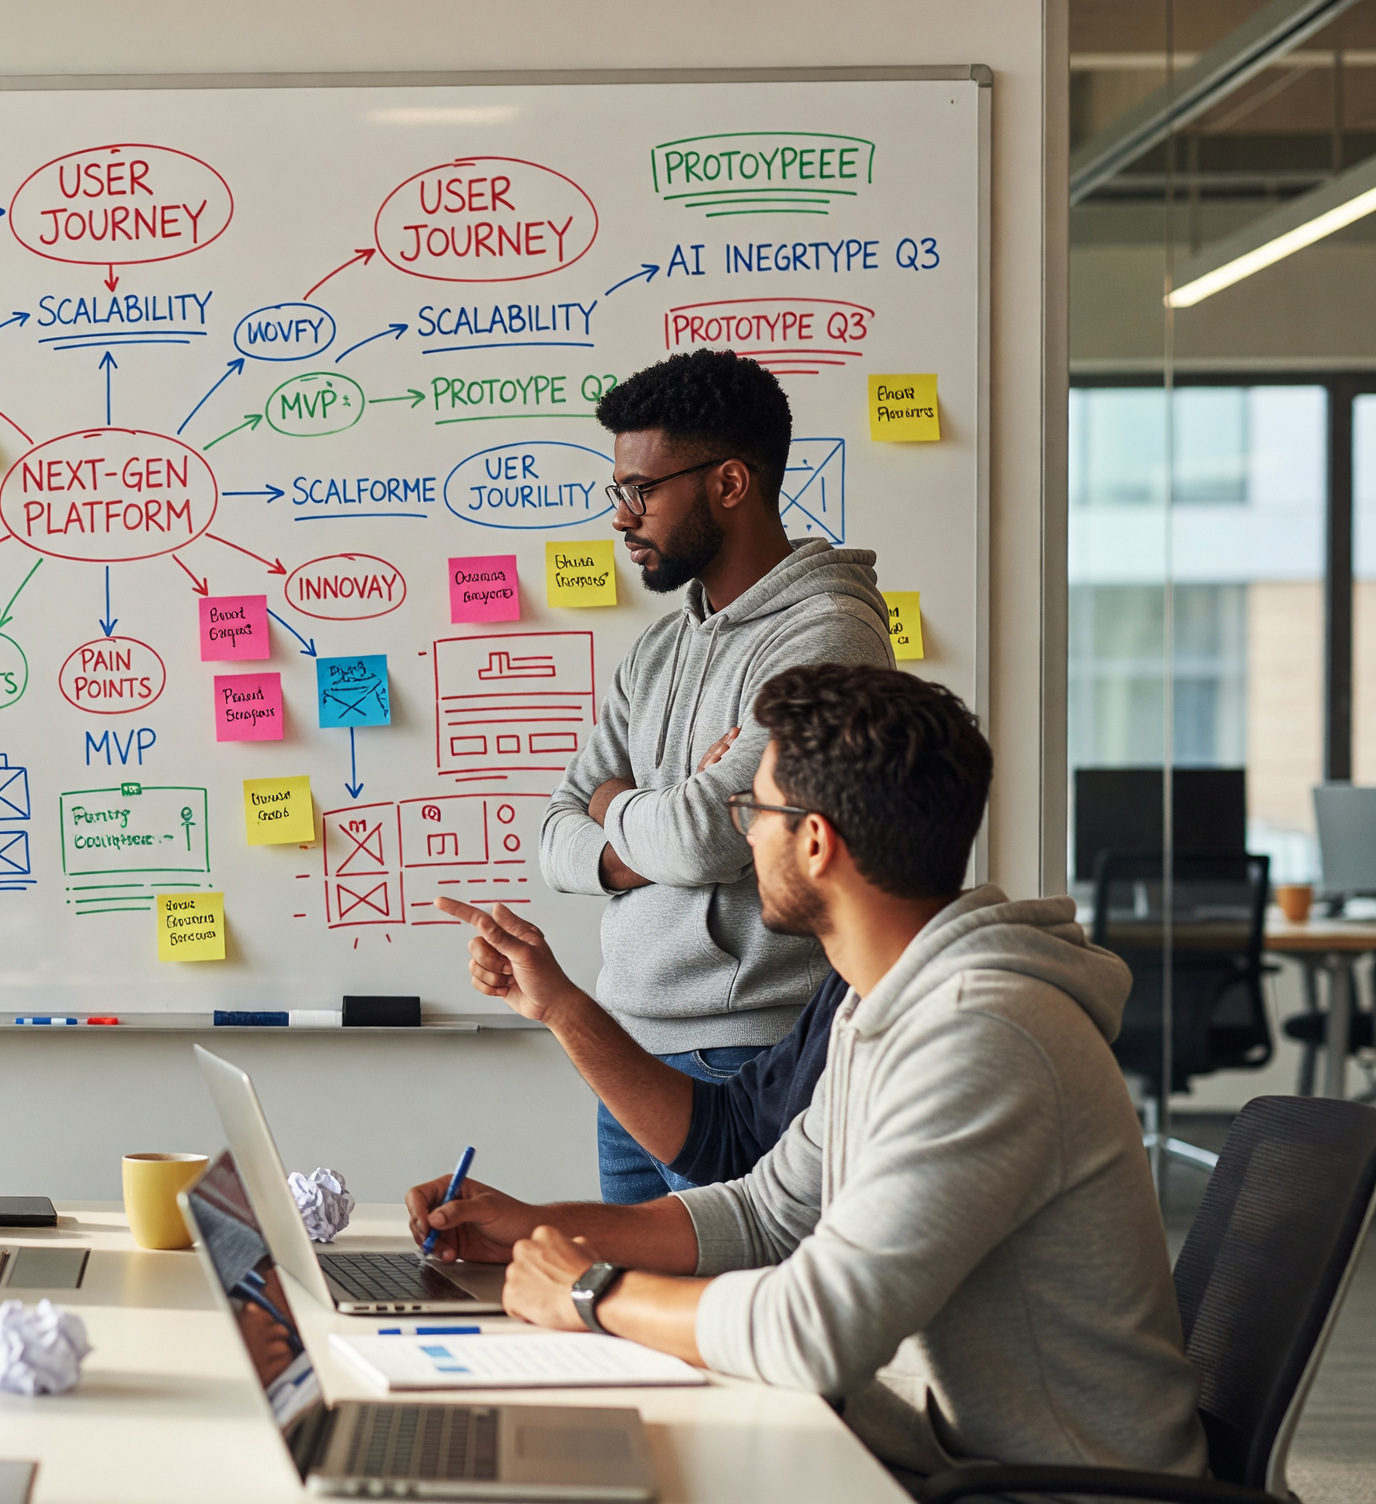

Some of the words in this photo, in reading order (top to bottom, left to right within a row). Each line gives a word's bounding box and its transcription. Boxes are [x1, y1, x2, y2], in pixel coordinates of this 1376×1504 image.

[59, 160, 154, 199] USER
[667, 148, 858, 182] PROTOYPEEE
[420, 176, 516, 216] USER
[40, 200, 208, 246] JOURNEY
[400, 216, 574, 263] JOURNEY
[668, 245, 705, 276] AI
[727, 240, 878, 272] INEGRTYPE
[897, 238, 940, 270] Q3
[39, 292, 213, 327] SCALABILITY
[419, 301, 597, 337] SCALABILITY
[673, 311, 815, 345] PROTOTYPE
[827, 312, 868, 343] Q3
[432, 376, 566, 409] PROTOYPE
[23, 456, 188, 493] NEXT-GEN
[486, 455, 539, 480] UER
[293, 477, 436, 506] SCALFORME
[469, 483, 595, 511] JOURILITY
[24, 499, 194, 537] PLATFORM
[299, 574, 397, 602] INNOVAY
[80, 649, 131, 672] PAIN
[75, 677, 153, 701] POINTS
[86, 728, 157, 766] MVP
